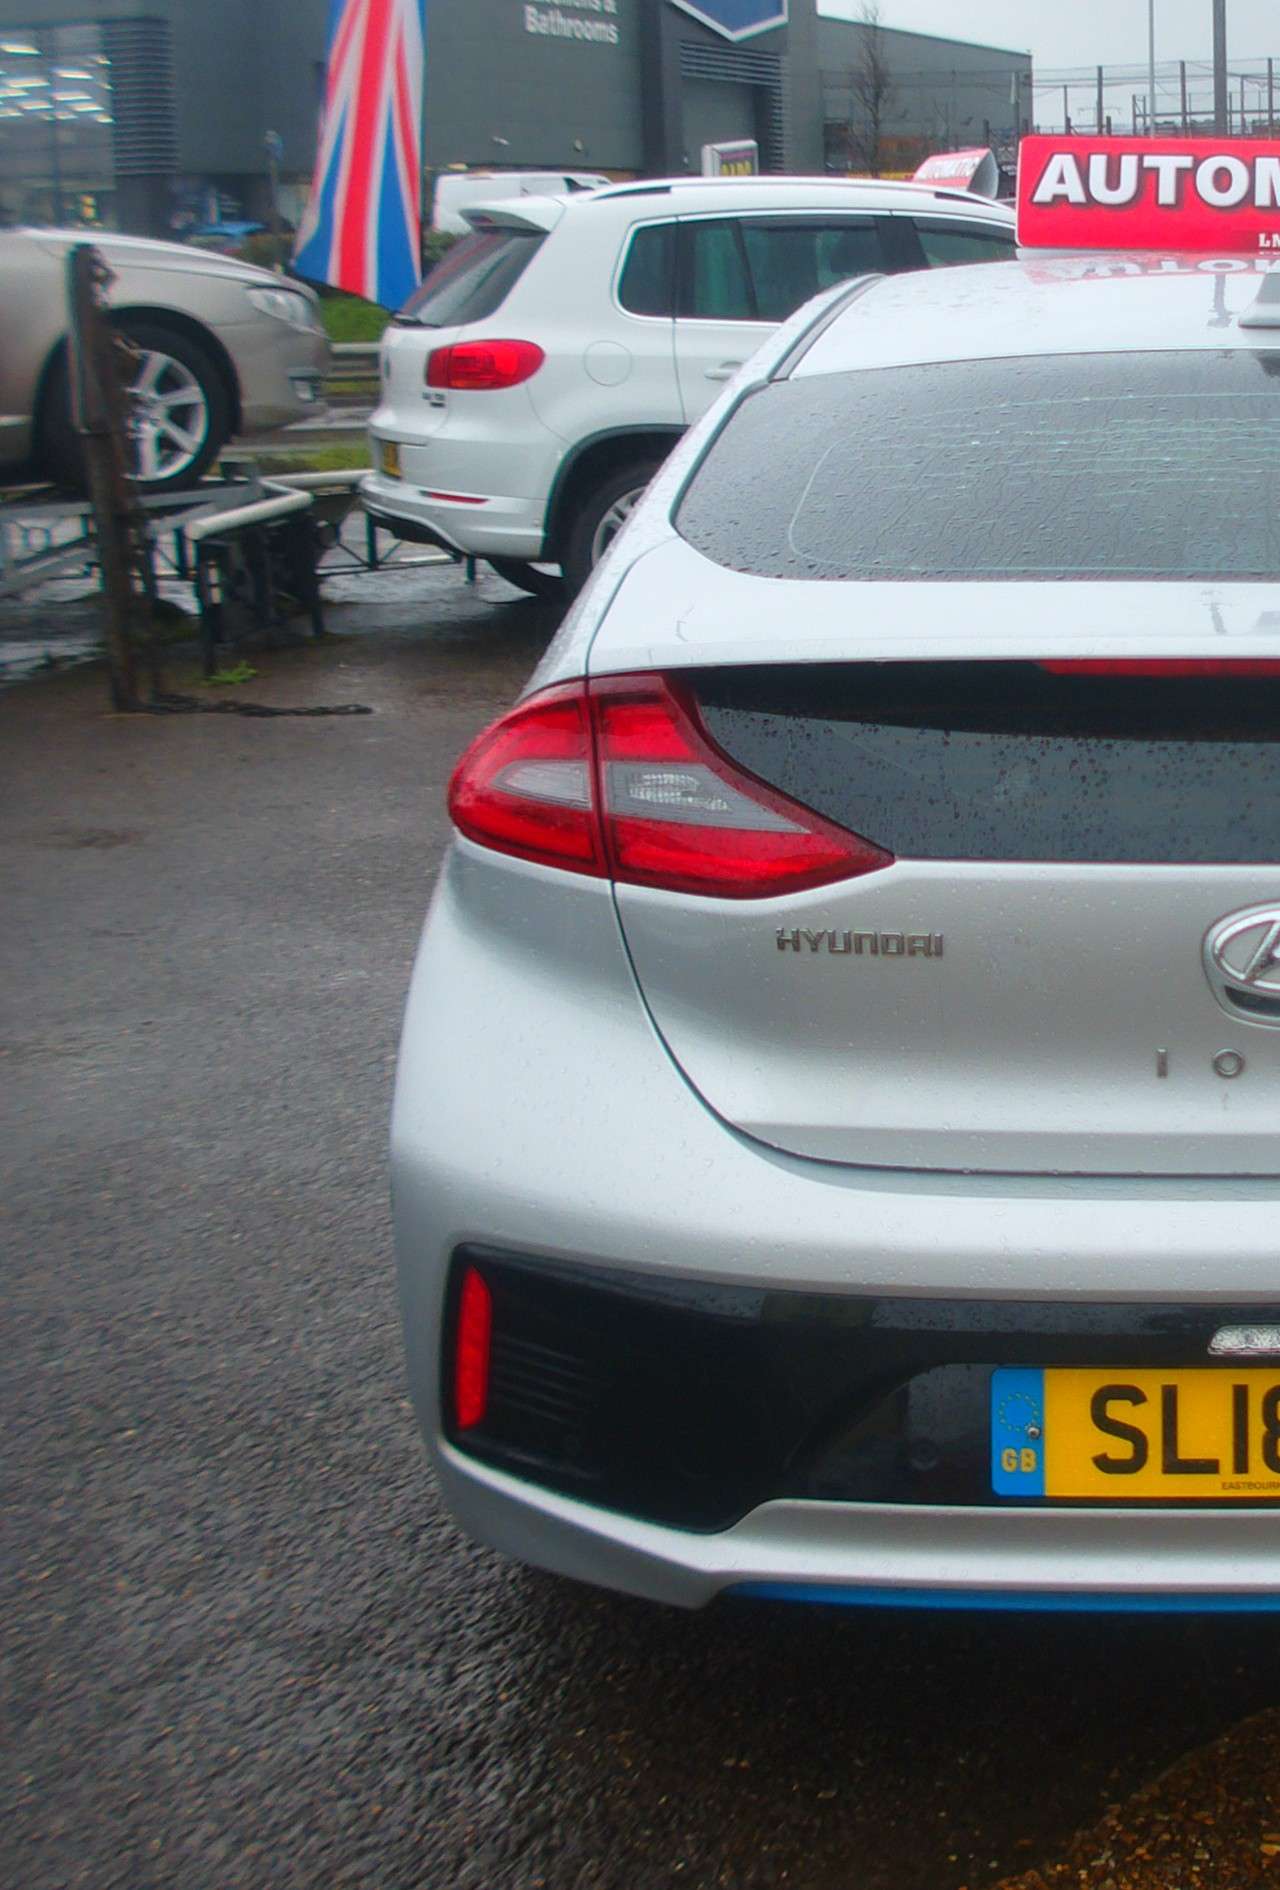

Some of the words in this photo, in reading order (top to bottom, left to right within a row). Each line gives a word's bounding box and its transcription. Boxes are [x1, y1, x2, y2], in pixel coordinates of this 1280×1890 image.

[524, 4, 619, 45] Bathrooms
[776, 928, 944, 958] HYUNDAI
[1001, 1448, 1036, 1473] GB
